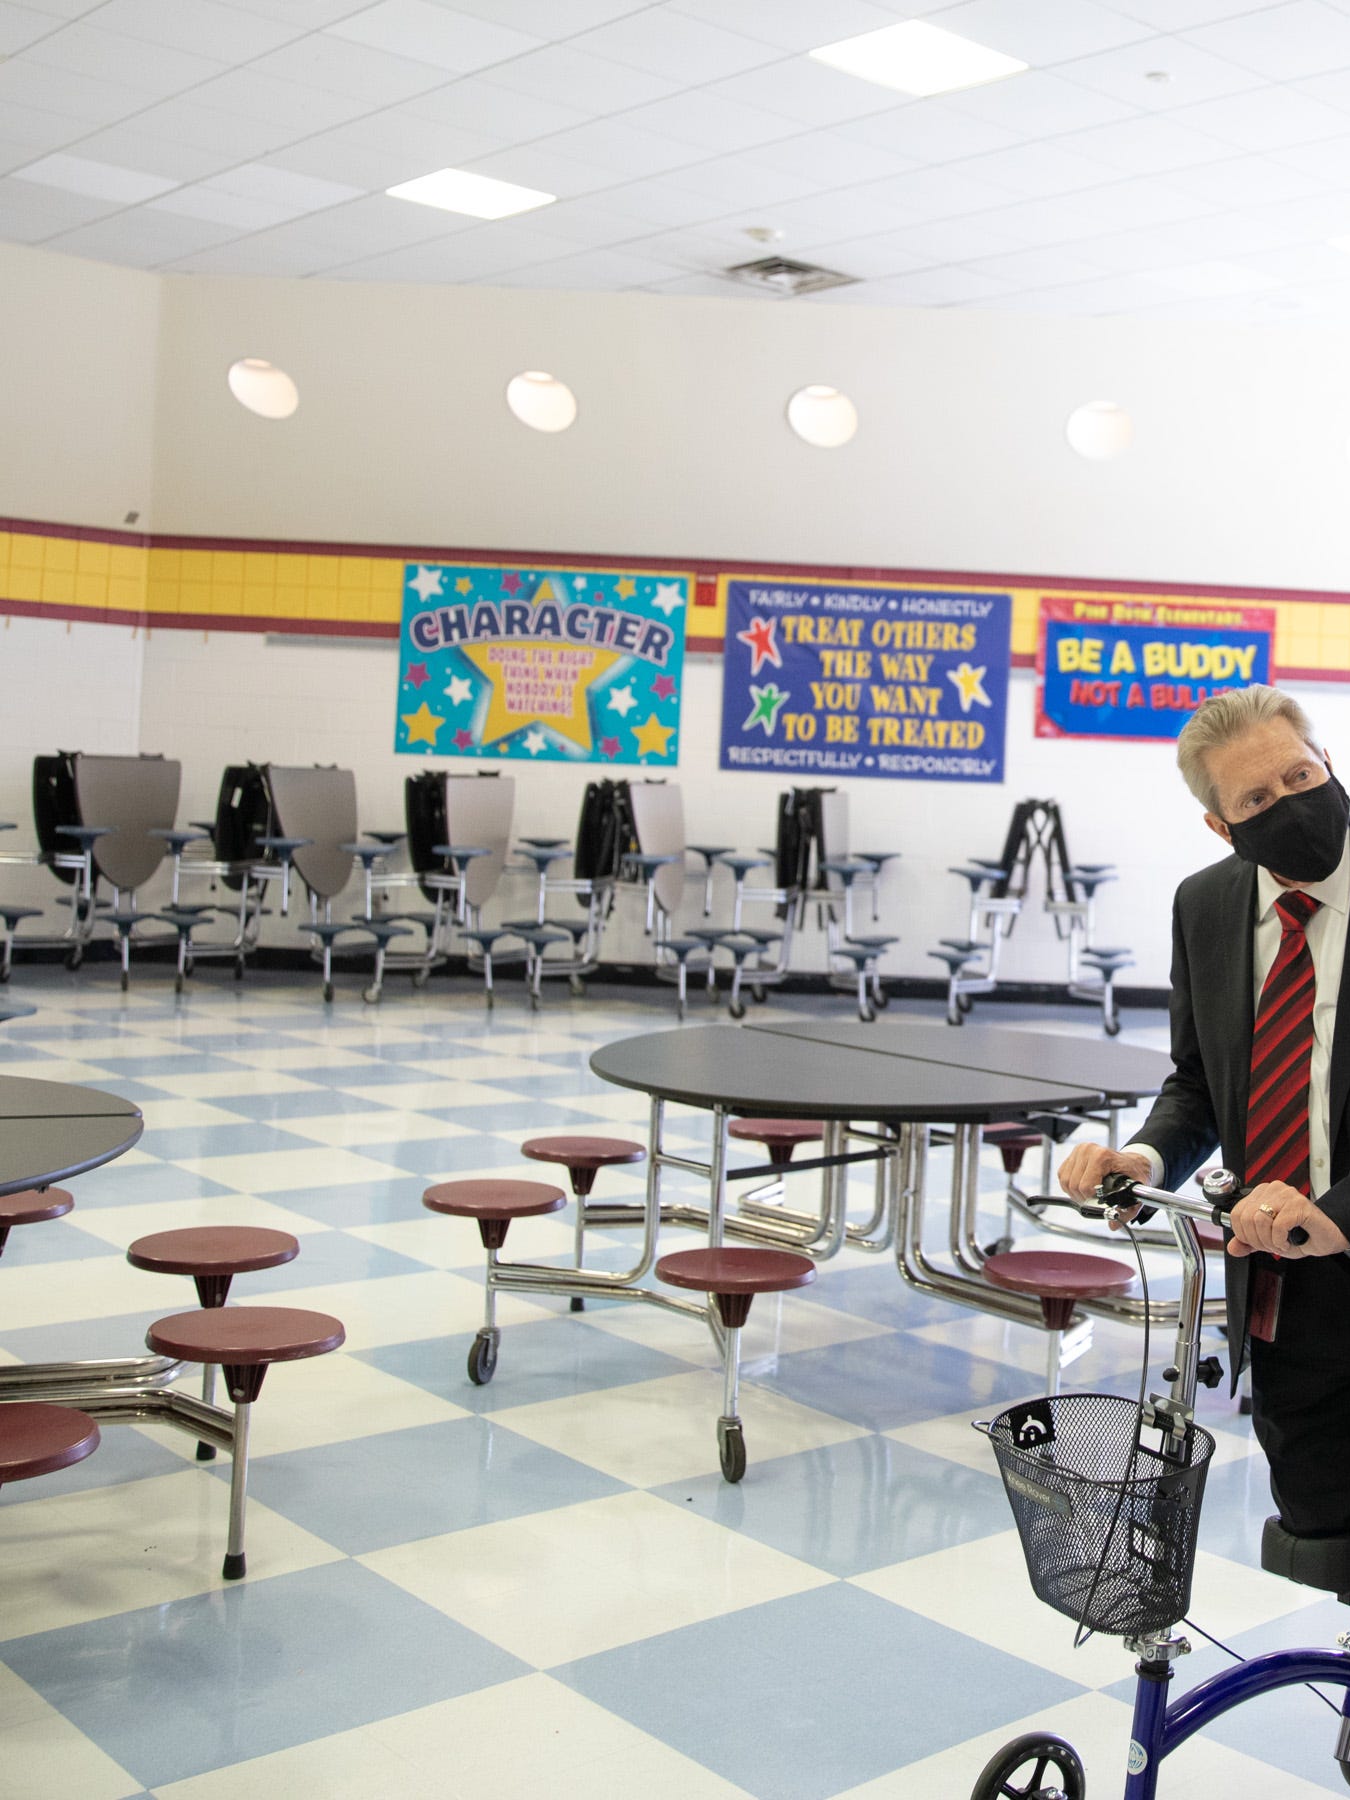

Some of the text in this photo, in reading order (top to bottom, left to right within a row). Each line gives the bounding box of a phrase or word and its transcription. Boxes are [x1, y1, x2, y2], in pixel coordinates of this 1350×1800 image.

[749, 589, 994, 618] FAIRLY KINDLY HONESTLY
[411, 602, 672, 665] CHARACTER
[781, 615, 977, 650] TREAT OTHERS
[820, 650, 935, 683] THE WAY
[1057, 638, 1257, 680] BE A BUDDY
[810, 682, 943, 716] YOU WANT
[1070, 679, 1122, 707] NOT
[1127, 682, 1145, 709] A
[782, 713, 986, 750] TO BE TREATED
[728, 746, 863, 769] RESPECTFULLY
